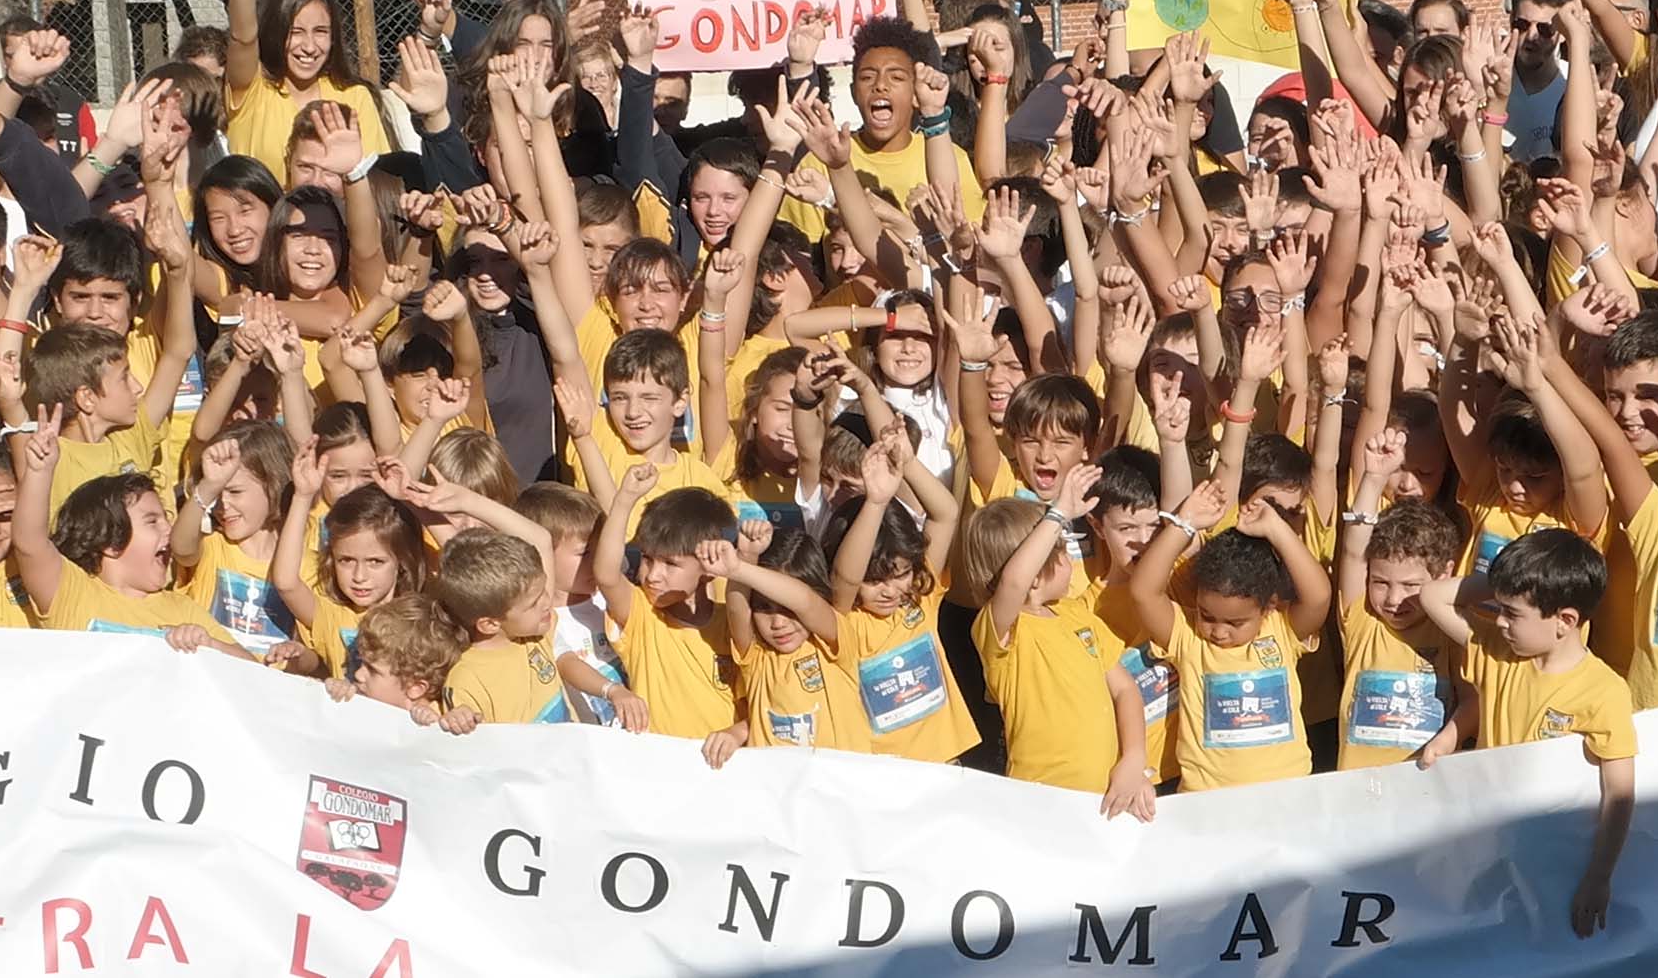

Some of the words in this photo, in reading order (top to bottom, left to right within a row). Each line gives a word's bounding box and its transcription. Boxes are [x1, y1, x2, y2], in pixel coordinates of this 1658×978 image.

[323, 792, 392, 823] GONDOMAR
[338, 785, 379, 802] COLEGIO
[483, 828, 1397, 967] GONDOMAR
